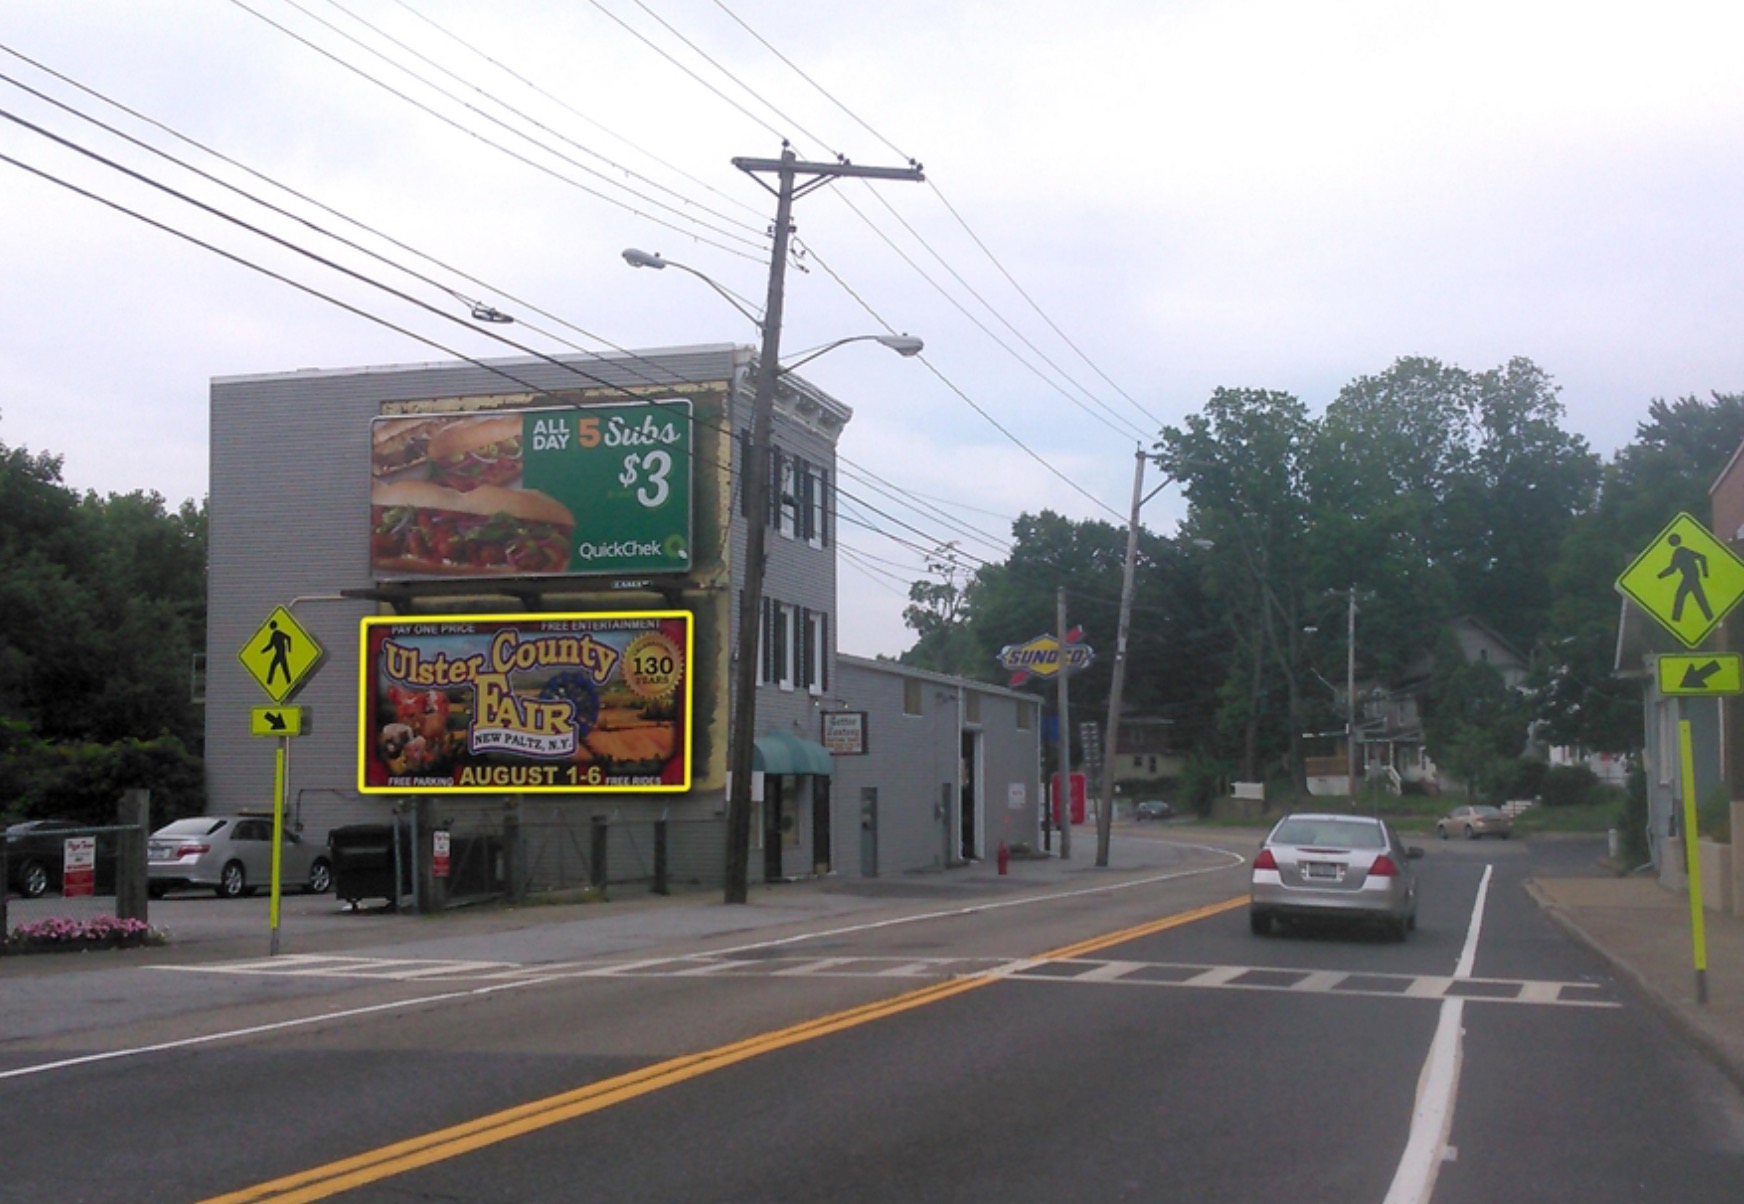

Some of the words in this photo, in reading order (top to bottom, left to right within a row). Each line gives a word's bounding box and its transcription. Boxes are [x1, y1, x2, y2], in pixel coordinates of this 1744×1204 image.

[533, 419, 570, 434] ALL
[578, 417, 601, 448] 5
[604, 415, 681, 446] Subs
[533, 434, 570, 450] DAY
[618, 450, 672, 507] $3
[579, 541, 661, 560] QuickChek
[391, 624, 414, 634] PAY
[413, 623, 438, 634] ONE
[440, 622, 475, 633] PRICE
[541, 620, 569, 631] FREE
[571, 618, 660, 630] ENTERTAINMENT
[384, 640, 483, 685] Ulster
[492, 631, 618, 681] County
[1008, 648, 1084, 665] SUNOO
[634, 657, 673, 675] 130
[473, 673, 574, 735] FAIR
[475, 732, 502, 745] NEW
[504, 733, 545, 751] PALTZ,
[548, 738, 573, 750] N.Y.
[387, 776, 411, 786] FREE
[413, 776, 454, 787] PARKING
[460, 766, 558, 786] AUGUST
[566, 765, 602, 785] 1-6
[605, 775, 629, 785] FREE
